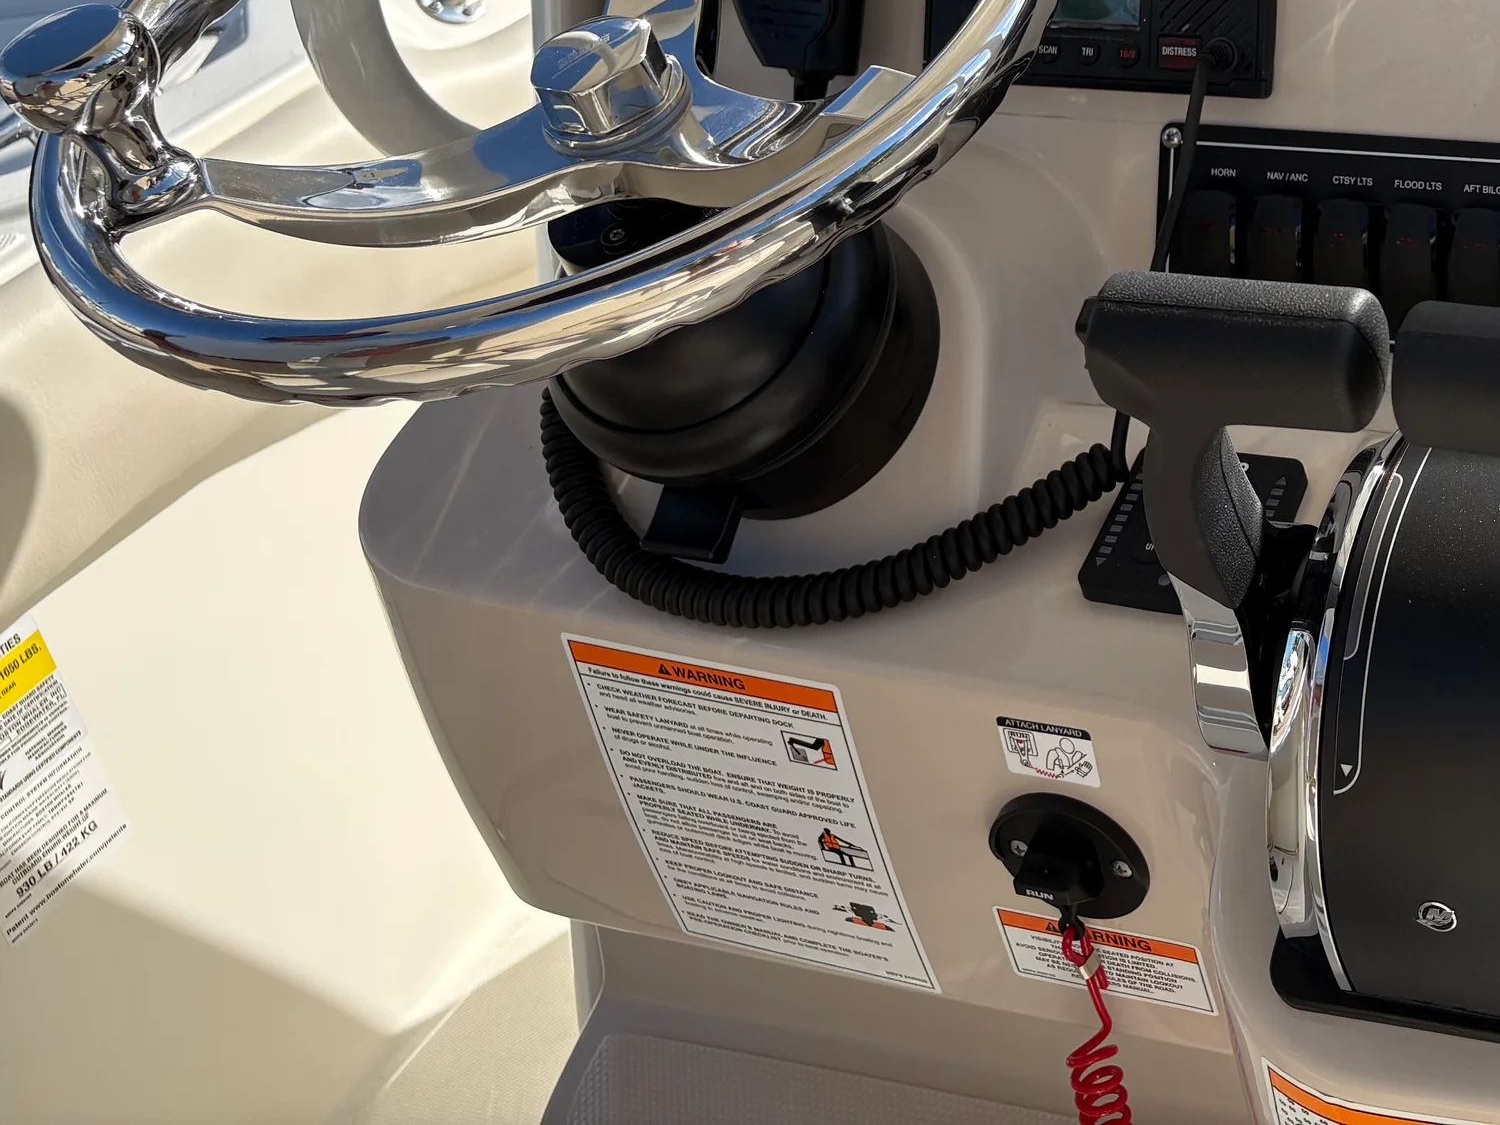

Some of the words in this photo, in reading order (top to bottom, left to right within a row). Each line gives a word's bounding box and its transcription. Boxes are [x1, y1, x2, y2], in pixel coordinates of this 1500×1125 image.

[1038, 45, 1057, 55] SCAN
[1081, 47, 1094, 56] TRI
[1162, 46, 1197, 57] DISTRESS
[1211, 168, 1236, 177] HORN
[1266, 171, 1284, 181] NAV
[1290, 173, 1309, 182] ANC
[1332, 175, 1356, 185] CTSY
[1357, 177, 1373, 186] LTS
[1394, 179, 1425, 189] FLOOD
[1426, 182, 1443, 191] LTS
[1463, 184, 1481, 193] AFT
[672, 665, 746, 690] WARNING
[588, 666, 611, 677] Failure
[620, 673, 640, 683] follow
[641, 678, 659, 687] these
[661, 681, 691, 693] warnings
[692, 689, 712, 698] could
[713, 693, 733, 702] cause
[734, 696, 763, 708] SEVERE
[764, 703, 790, 713] INJURY
[801, 710, 828, 721] DEATH.
[597, 683, 621, 694] CHECK
[622, 689, 657, 702] WEATHER
[659, 696, 696, 709] FORECAST
[698, 704, 728, 715] BEFORE
[729, 710, 771, 724] DEPARTING
[604, 705, 626, 716] WEAR
[627, 710, 654, 721] SAFETY
[655, 716, 688, 728] LANYARD
[1005, 719, 1039, 731] ATTACH
[1040, 724, 1082, 737] LANYARD
[612, 726, 635, 737] NEVER
[636, 732, 669, 744] OPERATE
[670, 738, 693, 749] WHILE
[694, 744, 720, 755] UNDER
[720, 749, 735, 758] THE
[736, 752, 778, 766] INFLUENCE
[16, 876, 37, 899] 930
[37, 859, 53, 879] LB
[61, 836, 81, 858] 422
[80, 819, 99, 840] KG
[1026, 889, 1054, 901] RUN
[6, 913, 29, 936] Patent
[1089, 931, 1152, 951] RNING
[1102, 949, 1129, 959] SEATED
[1130, 954, 1164, 965] POSITION
